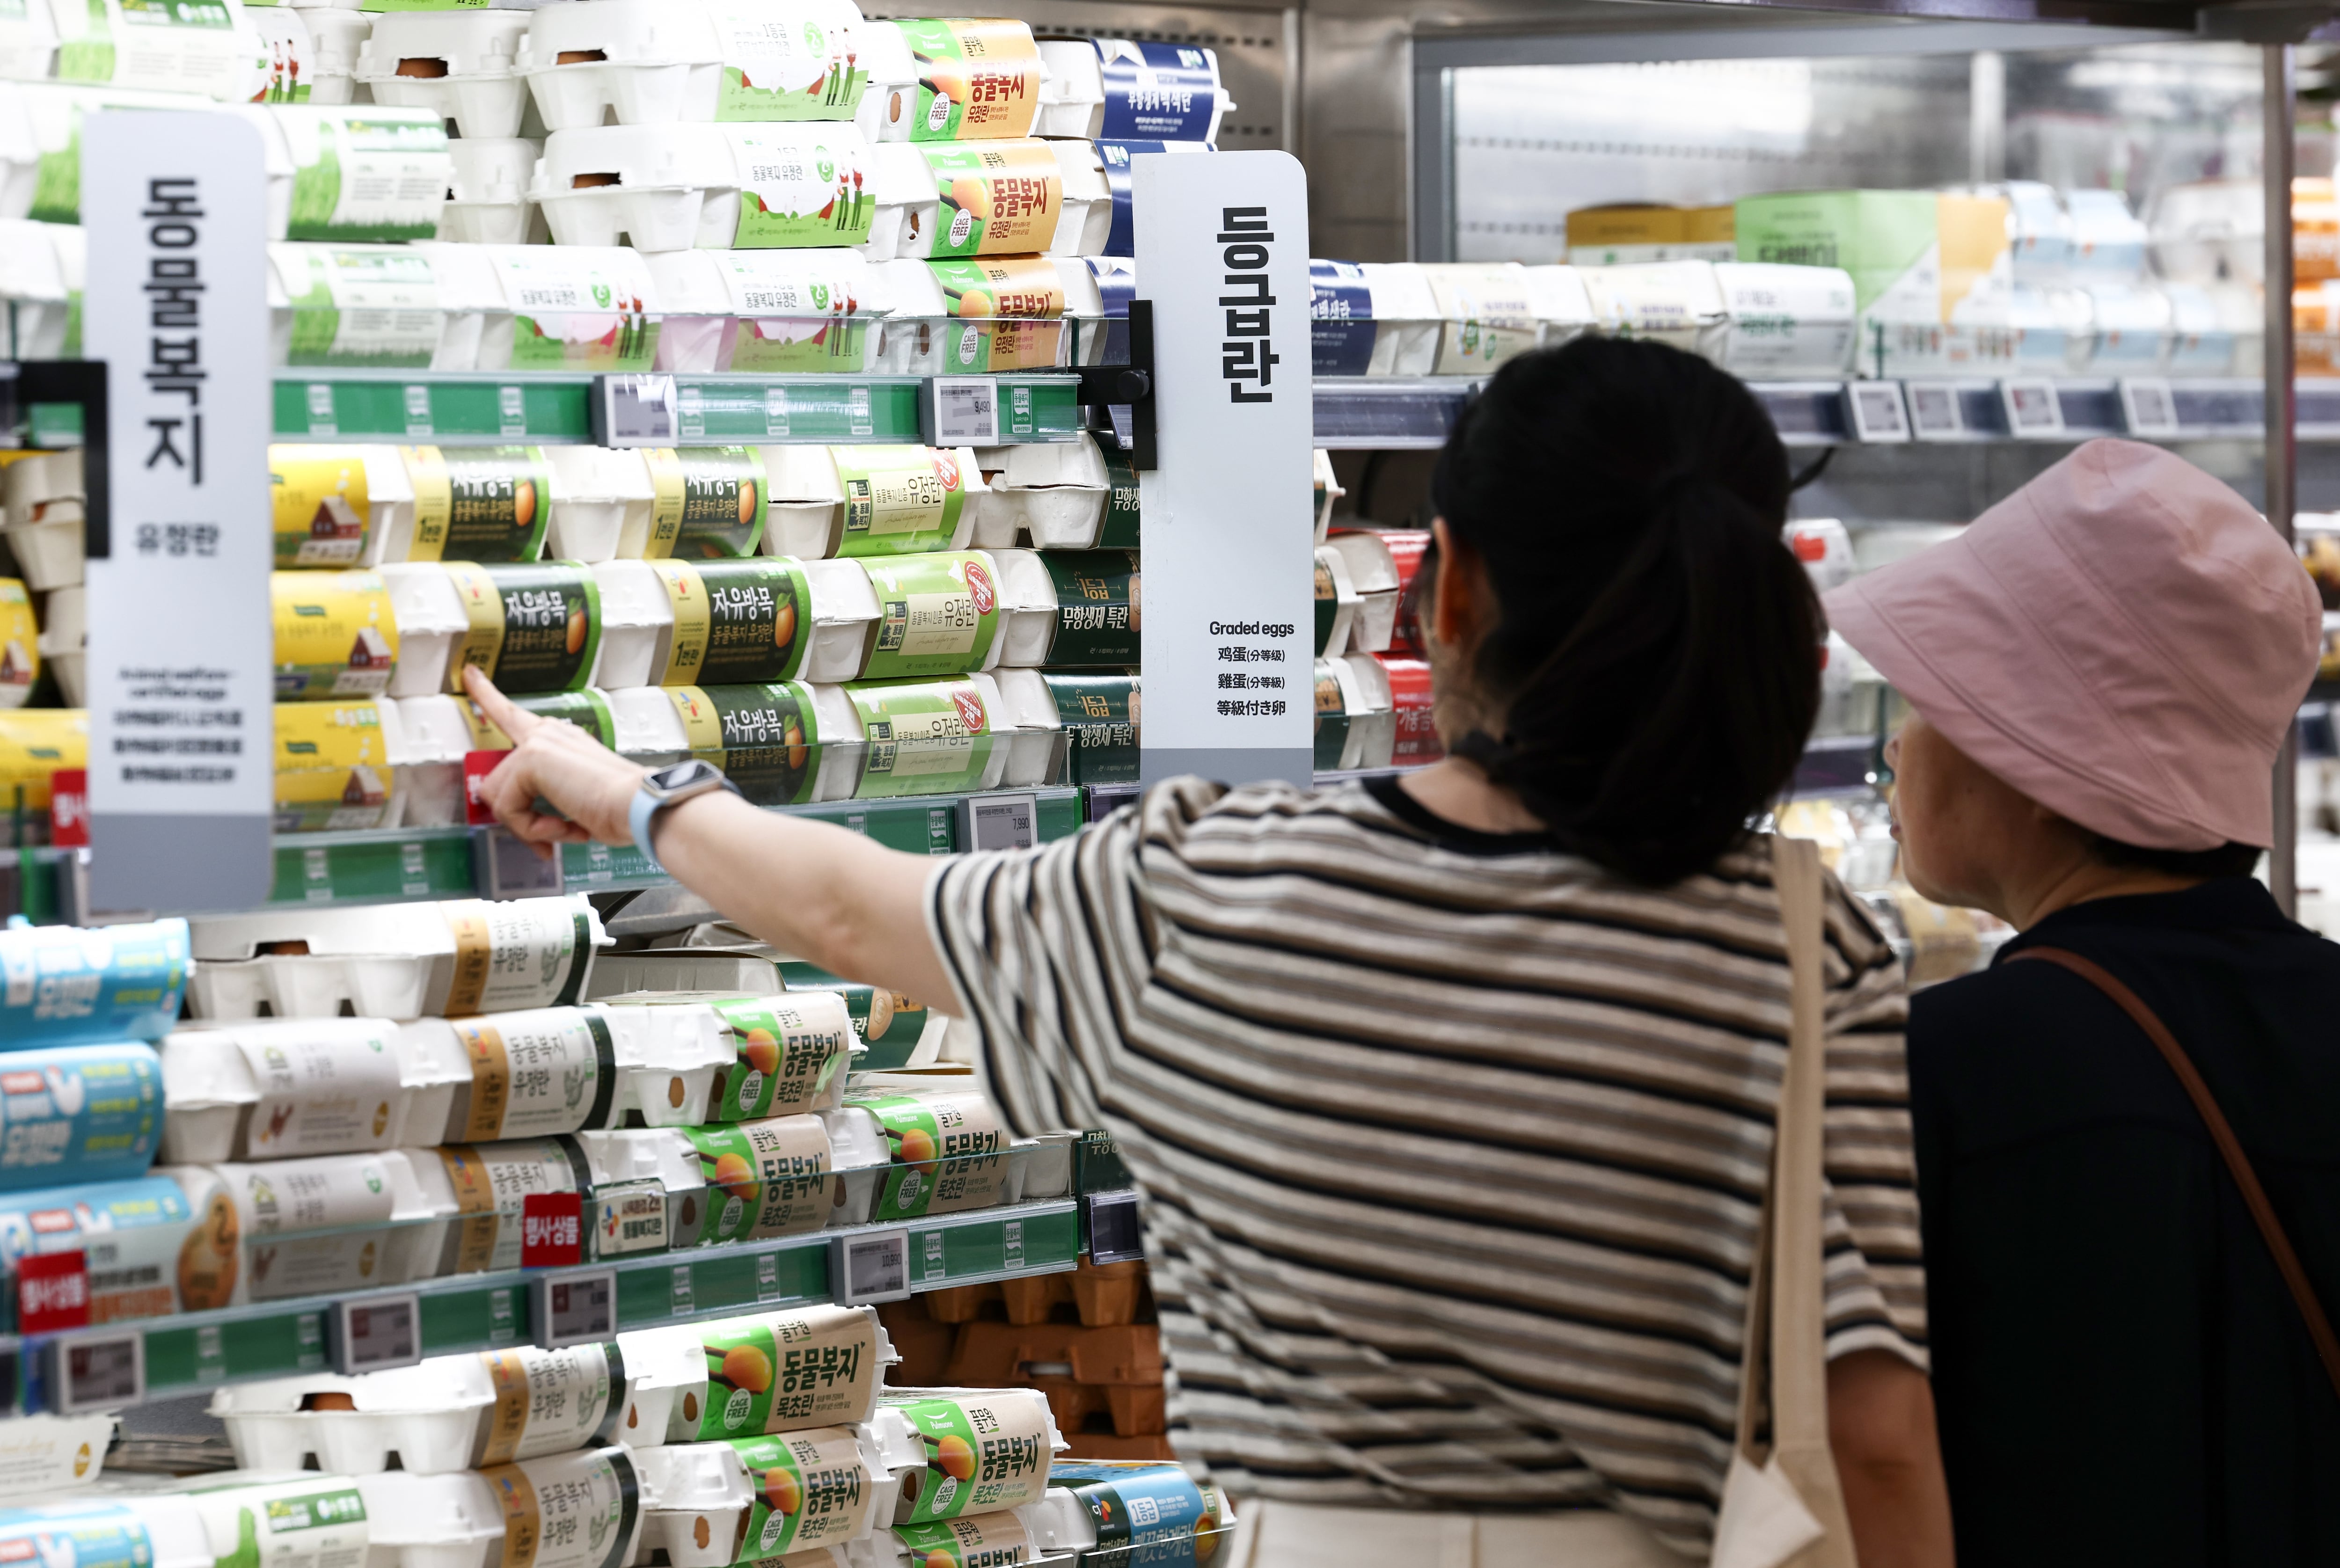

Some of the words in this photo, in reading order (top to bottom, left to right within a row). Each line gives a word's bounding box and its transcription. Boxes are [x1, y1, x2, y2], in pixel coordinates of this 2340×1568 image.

[962, 36, 985, 56] 풀무원
[930, 110, 947, 120] FREE
[967, 105, 990, 123] 유정란
[993, 176, 1048, 219] 동물복지
[951, 227, 969, 236] FREE
[989, 221, 1011, 239] 유정란
[996, 294, 1050, 333] 동물복지
[1217, 206, 1280, 403] 등급란
[142, 179, 206, 487] 동물복지
[961, 344, 976, 353] FREE
[995, 335, 1015, 354] 유정란
[975, 401, 990, 414] 9,490
[1015, 394, 1028, 403] 동물복지
[688, 463, 738, 495] 자유방목
[908, 475, 941, 504] 유정란
[977, 589, 986, 606] 2번
[1079, 578, 1109, 599] 1등급
[507, 591, 566, 626] 자유방목
[712, 586, 774, 620] 자유방목
[945, 598, 975, 627] 유정란
[1063, 606, 1105, 629] 무항생제
[1107, 606, 1128, 629] 특란
[713, 625, 747, 645] 동물복지
[748, 623, 774, 643] 유정란
[1210, 621, 1259, 635] Graded
[1262, 624, 1294, 637] eggs
[1218, 647, 1285, 663] 鸡蛋(分等级)
[1218, 673, 1285, 689] 雞蛋(分等級)
[964, 707, 975, 724] 2번
[1081, 696, 1110, 717] 1등급
[1217, 700, 1286, 715] 等級付き卵
[724, 708, 782, 743] 자유방목
[1013, 817, 1029, 831] 7,990
[741, 1089, 759, 1100] FREE
[778, 1080, 805, 1104] 목초란
[894, 1115, 918, 1123] Pulmuone
[933, 1104, 962, 1128] 풀무원
[943, 1130, 999, 1176] 동물복지
[763, 1154, 824, 1203] 동물복지
[936, 1177, 966, 1201] 목초란
[899, 1188, 918, 1199] FREE
[720, 1216, 739, 1226] FREE
[760, 1204, 792, 1228] 목초란
[525, 1216, 579, 1247] 행사상품
[1006, 1227, 1021, 1239] 동물복지
[882, 1253, 901, 1268] 10,990
[775, 1318, 812, 1343] 풀무원
[782, 1344, 859, 1393] 동물복지
[726, 1407, 748, 1419] FREE
[730, 1398, 748, 1408] CAGE
[777, 1393, 814, 1419] 목초란
[930, 1421, 954, 1429] Pulmuone
[969, 1408, 998, 1434] 풀무원
[790, 1440, 819, 1466] 풀무원
[983, 1435, 1038, 1481] 동물복지
[807, 1467, 861, 1516] 동물복지
[934, 1494, 953, 1504] FREE
[940, 1486, 955, 1494] CAGE
[972, 1482, 1004, 1505] 목초란
[1092, 1504, 1101, 1516] CJ
[1132, 1501, 1156, 1523] 1등급
[762, 1528, 780, 1540] FREE
[767, 1519, 782, 1528] CAGE
[798, 1517, 829, 1541] 목초란
[953, 1521, 982, 1547] 풀무원
[918, 1535, 941, 1544] Pulmuone
